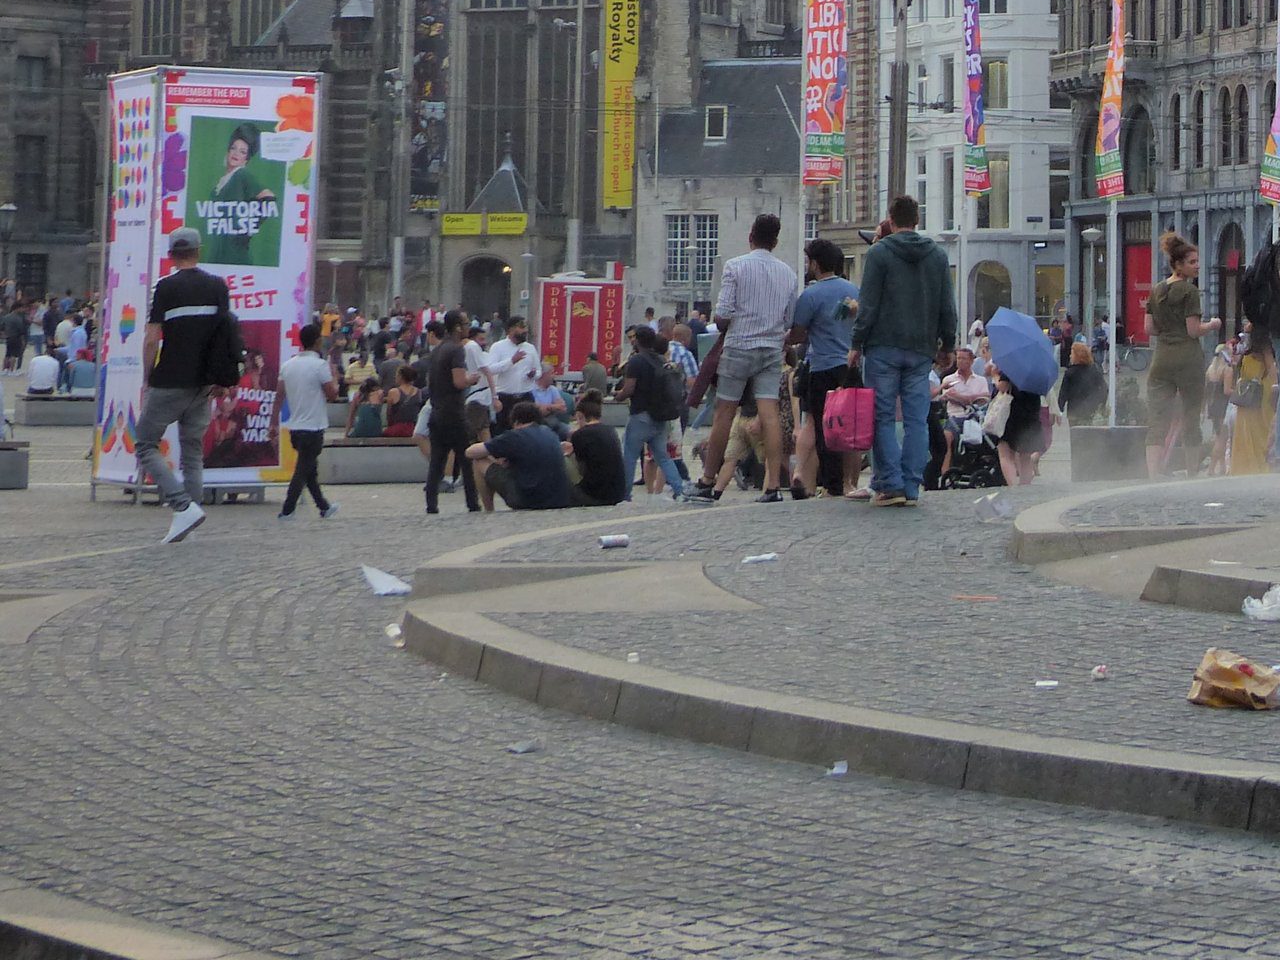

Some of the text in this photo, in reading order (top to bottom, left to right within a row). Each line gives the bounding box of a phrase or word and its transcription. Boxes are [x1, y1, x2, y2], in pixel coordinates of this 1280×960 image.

[609, 2, 624, 64] Royalty
[168, 86, 248, 98] REMEMBER THE PAST
[196, 200, 279, 218] VICTORIA
[207, 218, 260, 235] FALSE
[229, 290, 278, 309] TEST
[549, 286, 560, 349] DRINKS
[604, 288, 616, 361] HOTDOGS
